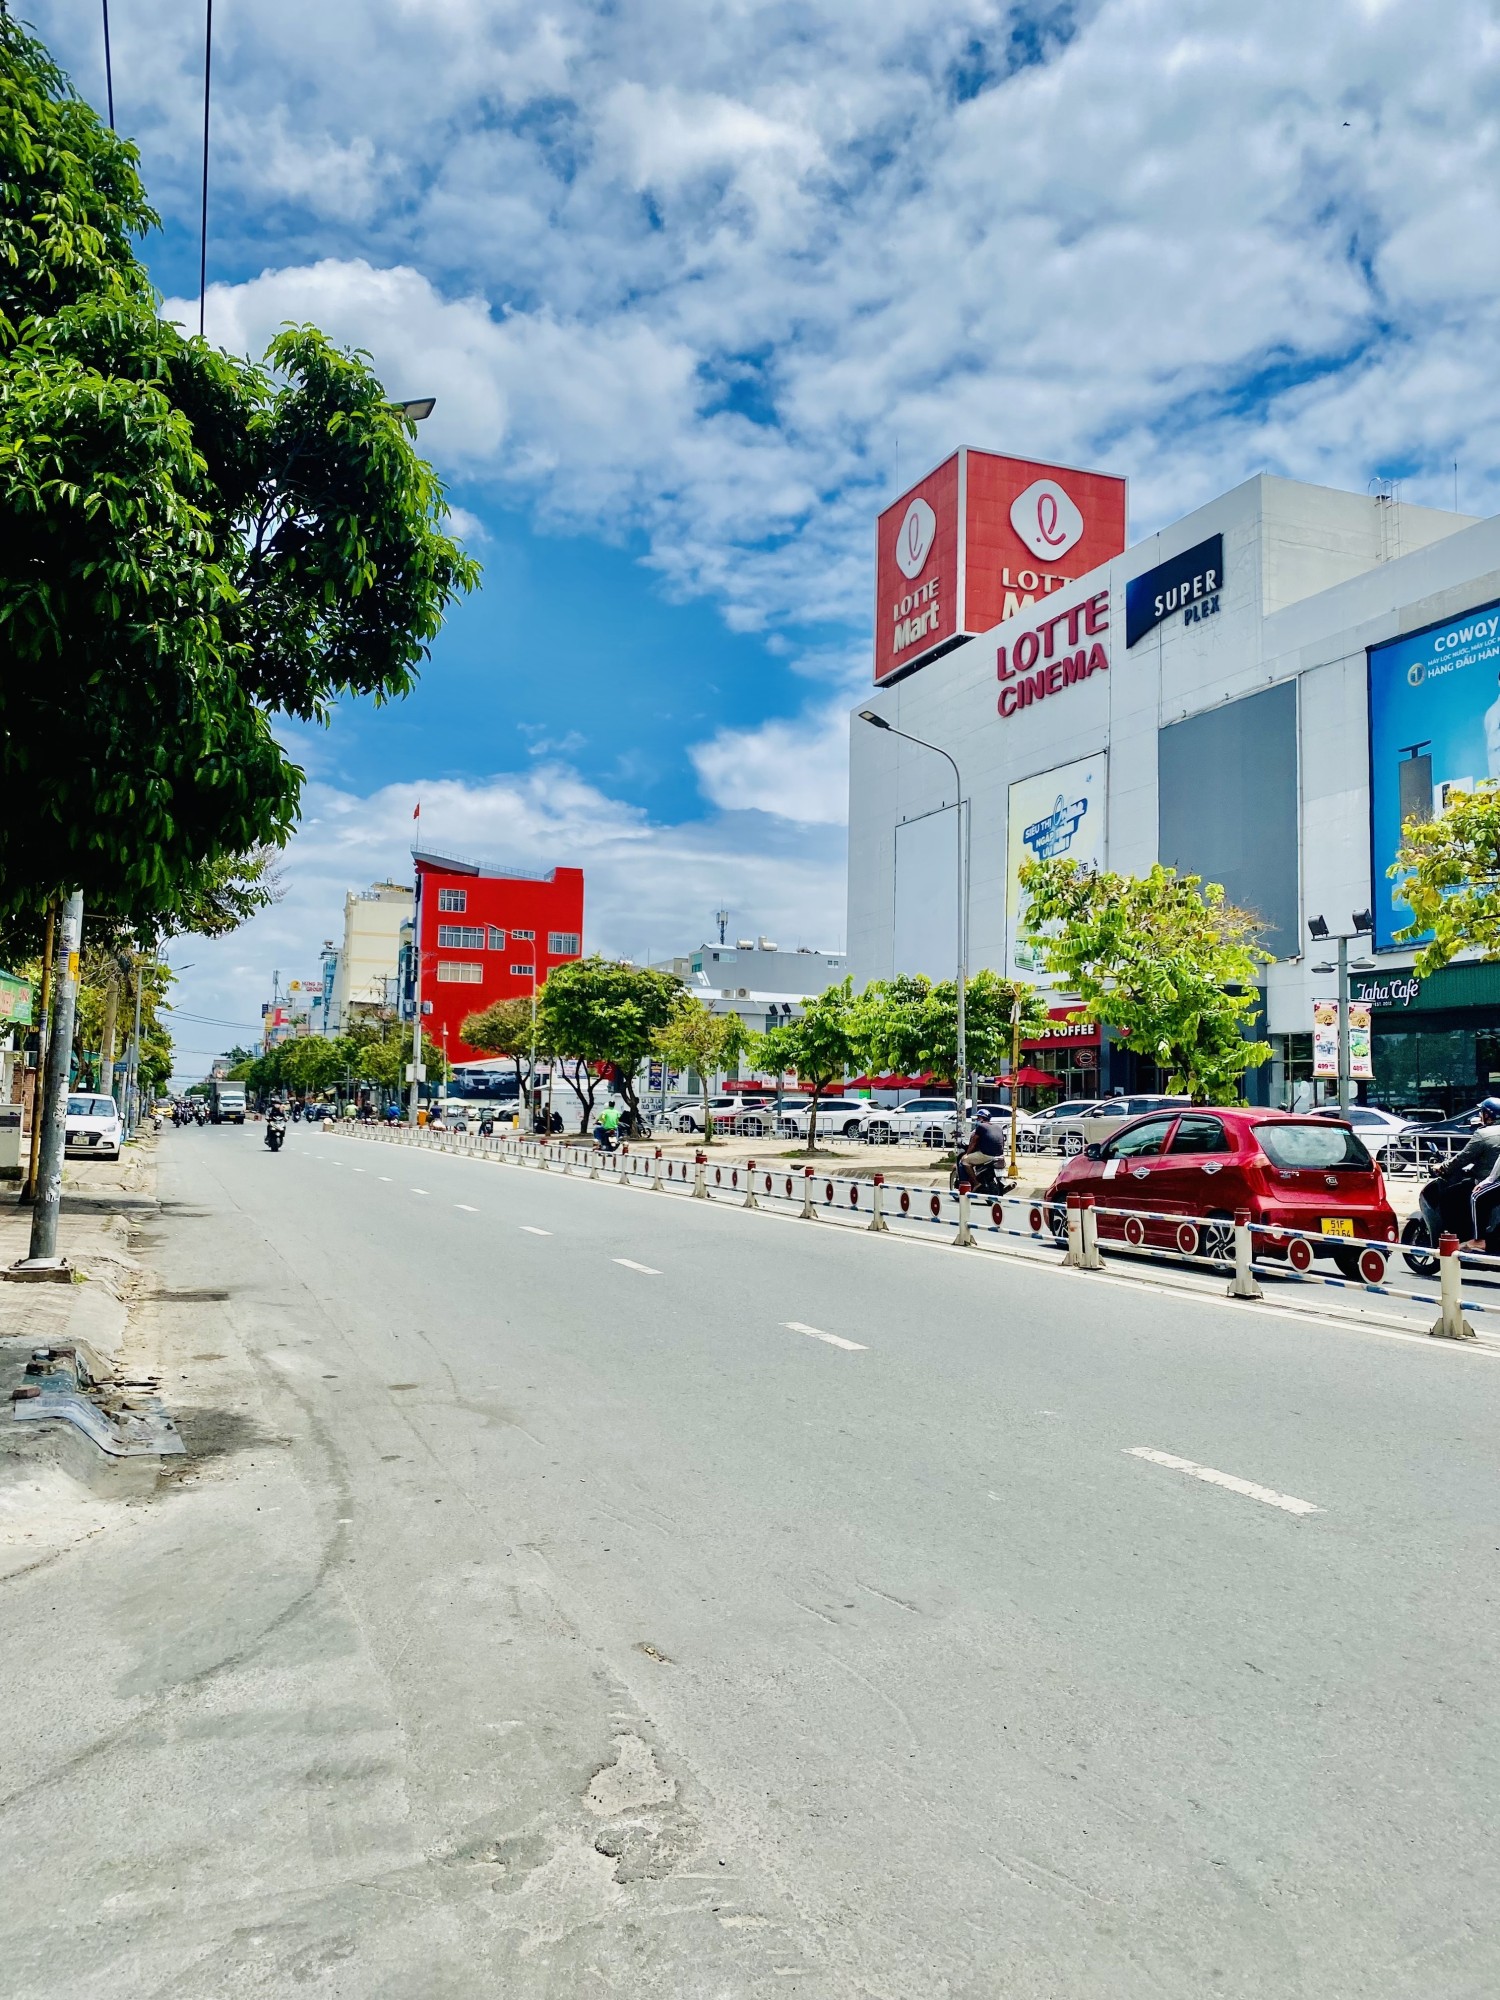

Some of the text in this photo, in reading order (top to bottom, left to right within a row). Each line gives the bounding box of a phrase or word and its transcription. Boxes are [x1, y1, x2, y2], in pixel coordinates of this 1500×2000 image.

[1002, 568, 1074, 593] LOTT
[1155, 569, 1217, 617] SUPER
[893, 577, 940, 622] LOTTE
[1184, 594, 1220, 627] PLEX
[893, 600, 940, 655] Mart
[997, 590, 1109, 681] LOTTE
[1434, 616, 1499, 652] coway
[1427, 662, 1454, 679] HÀNG
[1478, 645, 1500, 661] HÀN
[997, 643, 1109, 718] CINEMA
[1389, 979, 1420, 1007] Café
[1053, 1024, 1095, 1038] COFFEE
[1330, 1219, 1345, 1229] 51F
